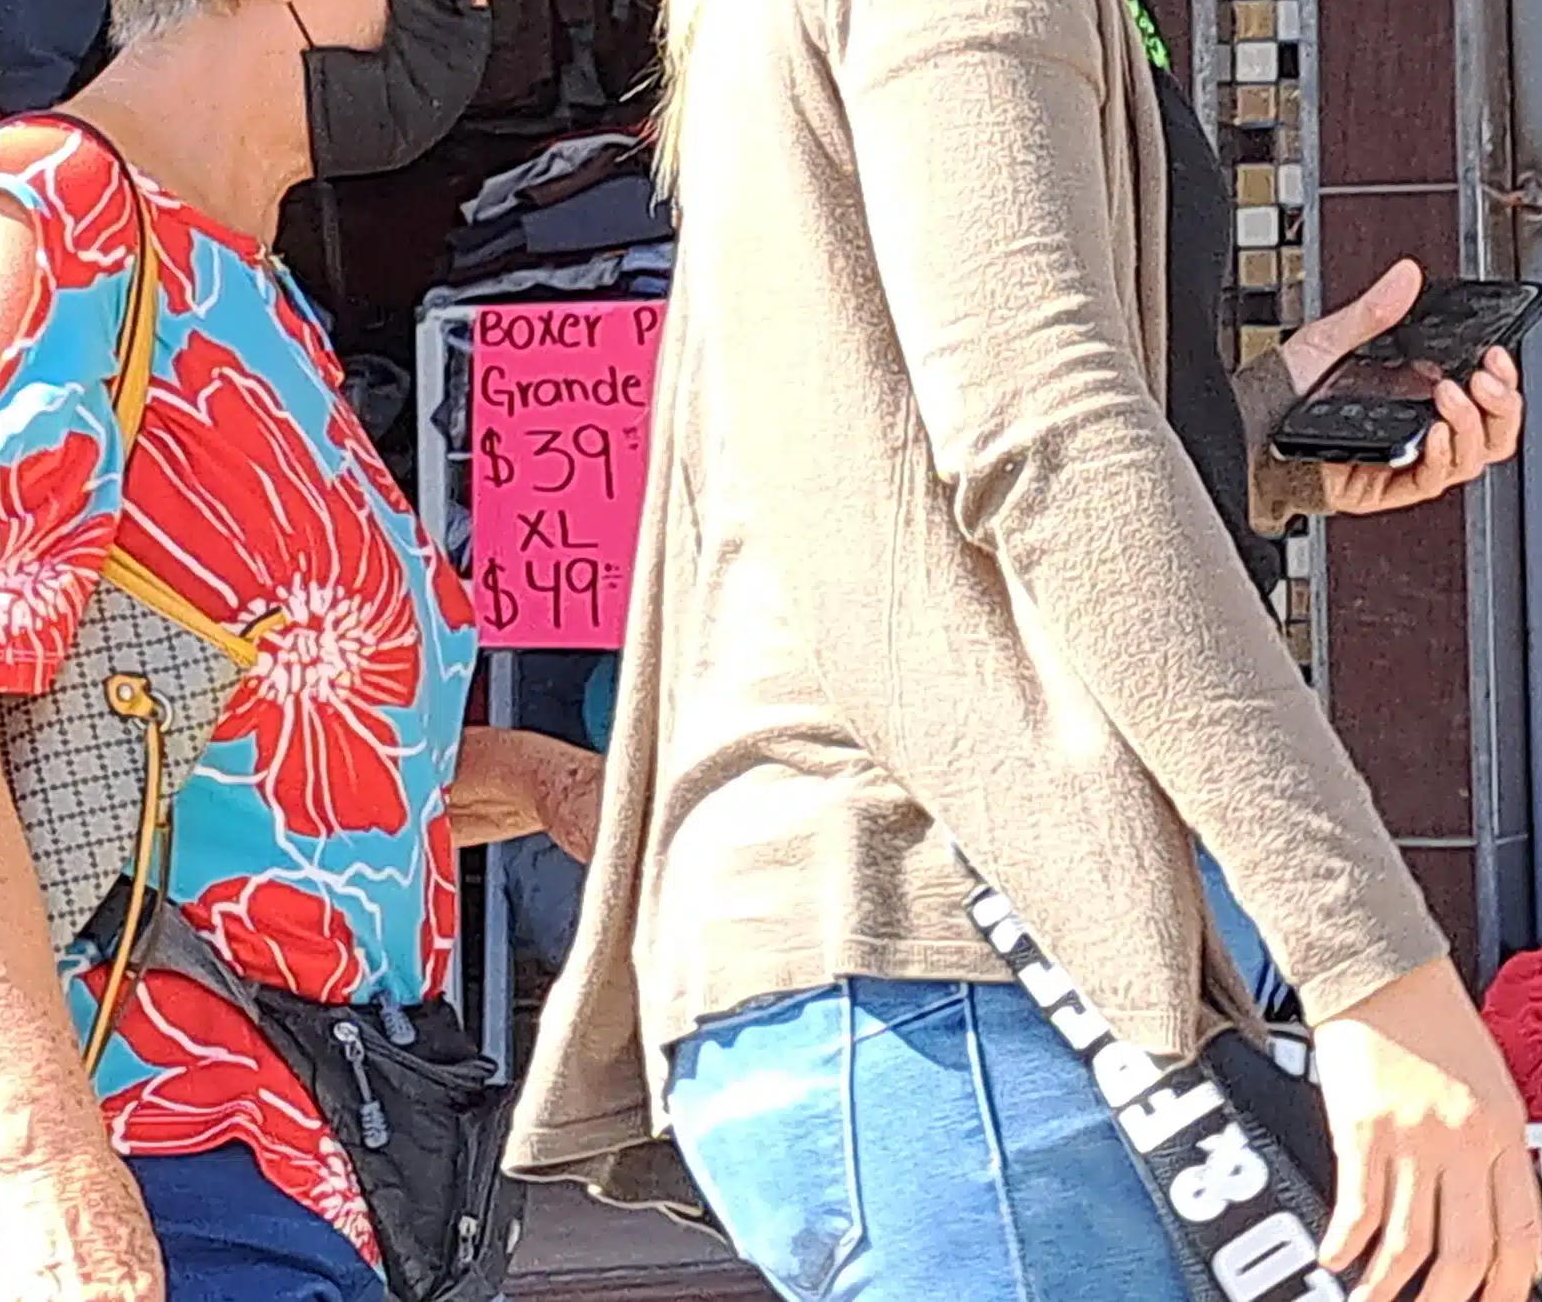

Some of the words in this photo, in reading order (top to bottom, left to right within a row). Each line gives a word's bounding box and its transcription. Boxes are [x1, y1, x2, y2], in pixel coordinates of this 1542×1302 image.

[478, 309, 603, 350] Boxer
[480, 364, 649, 418] Grande
[516, 508, 600, 552] XL
[1168, 1121, 1271, 1223] &
